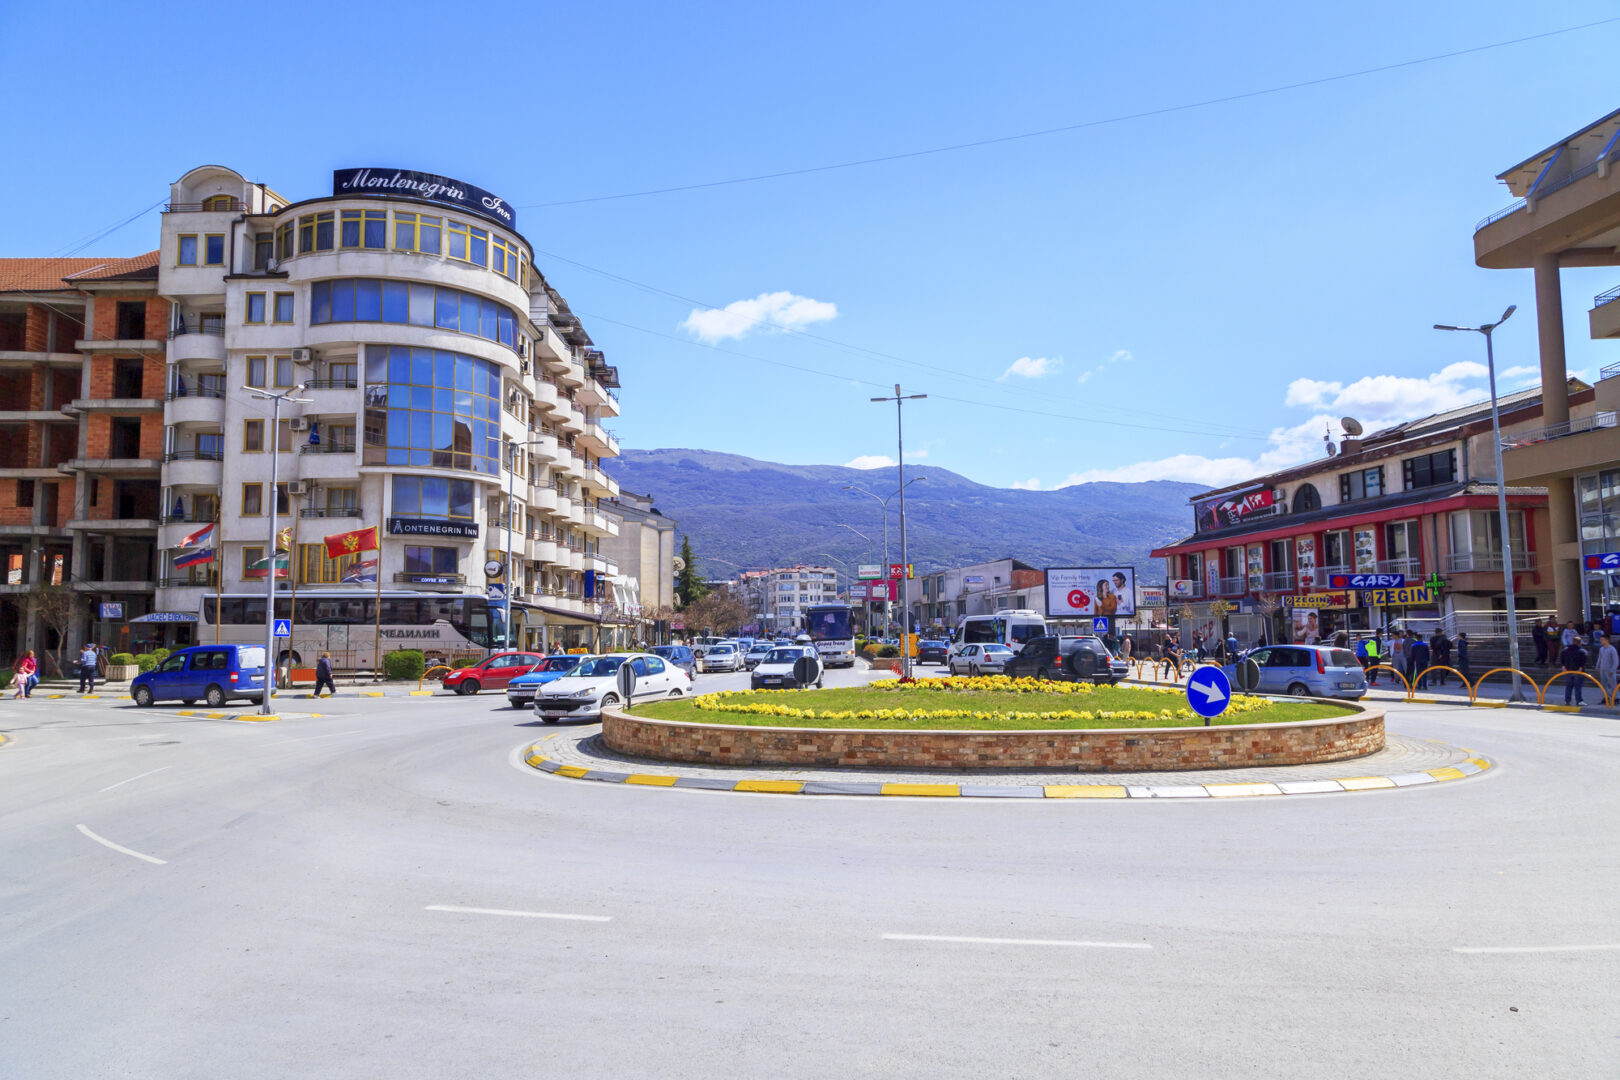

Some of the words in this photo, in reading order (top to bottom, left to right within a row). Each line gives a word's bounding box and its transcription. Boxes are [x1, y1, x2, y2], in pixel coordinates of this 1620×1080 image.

[342, 168, 465, 200] Montenegrin
[481, 196, 511, 221] Inn
[1351, 575, 1400, 587] GARY
[1375, 588, 1429, 604] ZEGIN
[379, 629, 440, 639] МЕДИЛИН
